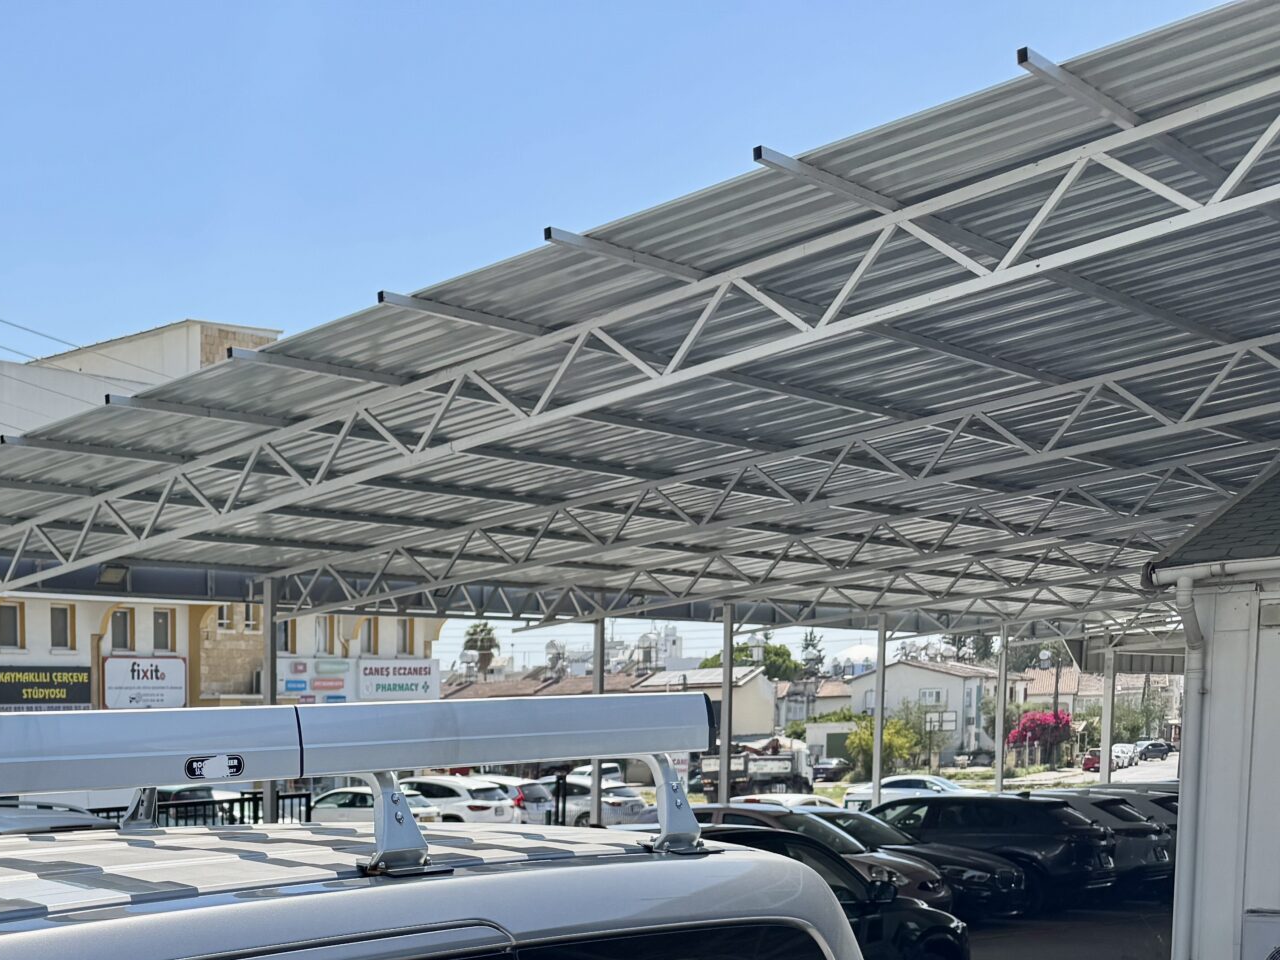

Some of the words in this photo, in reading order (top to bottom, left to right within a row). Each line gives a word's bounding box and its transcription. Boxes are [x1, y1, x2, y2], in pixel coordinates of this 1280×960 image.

[130, 661, 160, 680] fixit
[52, 672, 89, 685] ÇERÇEVE
[22, 687, 66, 699] STÜDYOSU
[375, 683, 419, 692] PHARMACY
